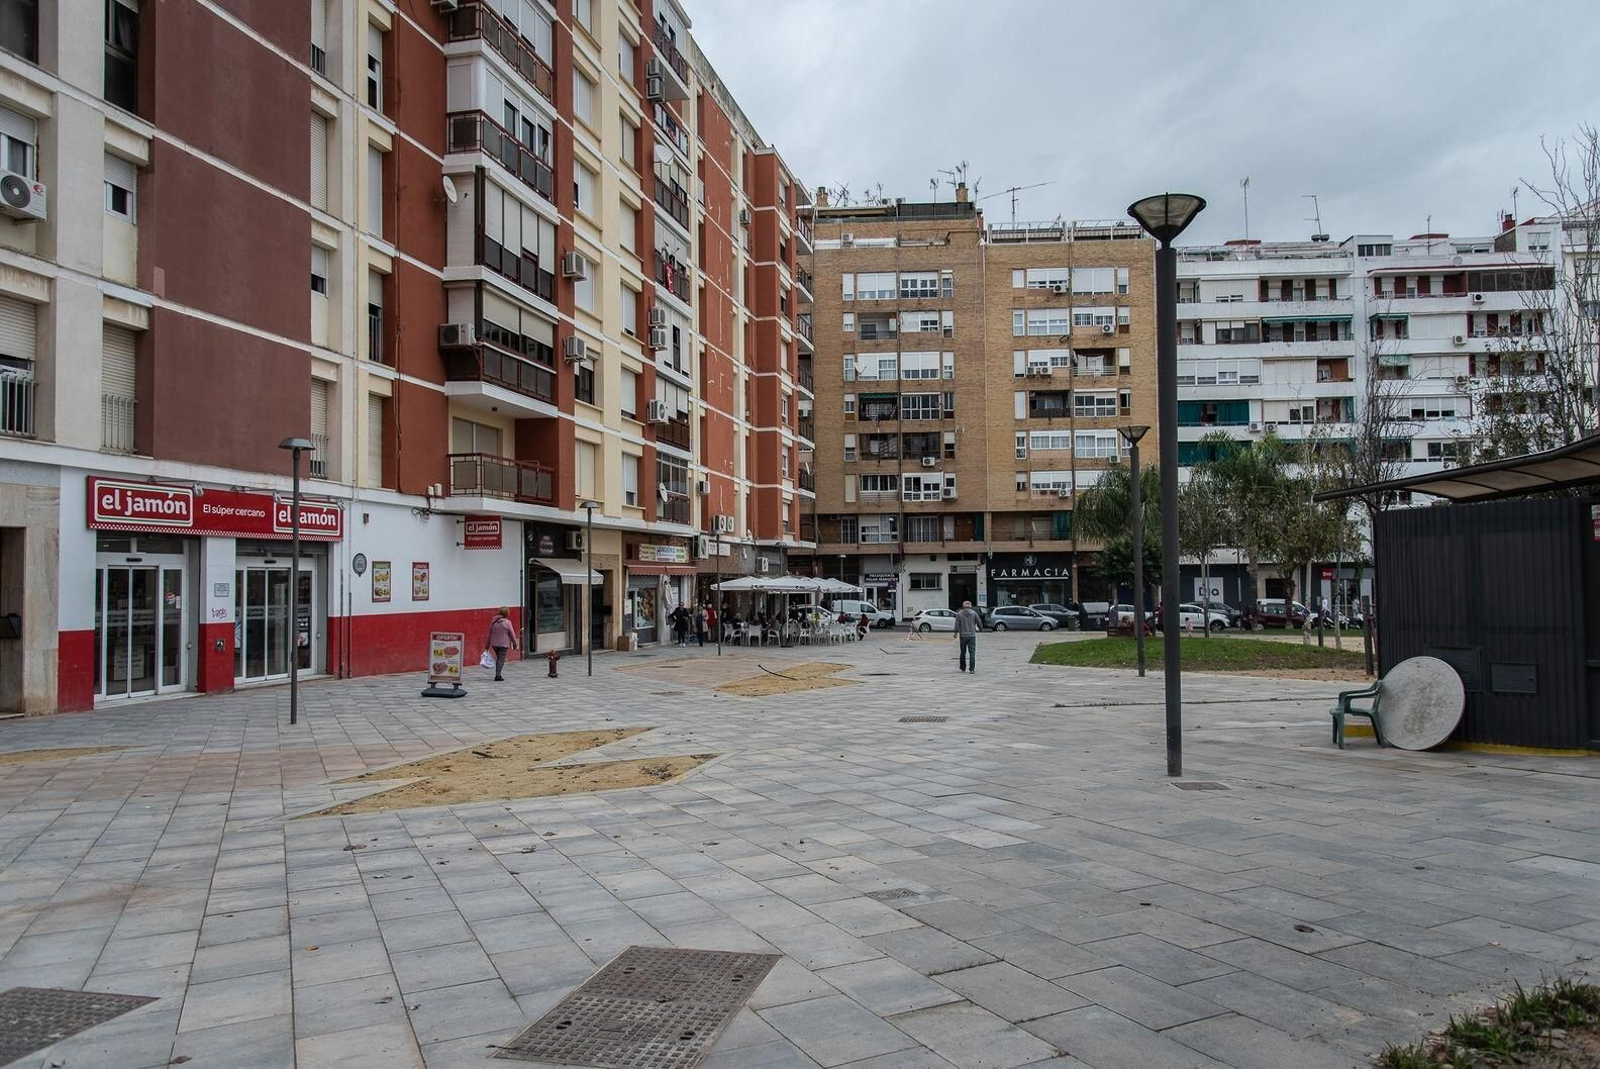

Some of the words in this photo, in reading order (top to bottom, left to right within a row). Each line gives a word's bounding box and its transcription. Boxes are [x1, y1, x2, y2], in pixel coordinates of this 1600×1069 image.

[102, 489, 121, 510] el
[124, 490, 187, 516] jamón
[203, 504, 211, 514] El
[212, 505, 235, 516] súper
[235, 508, 265, 518] cercano
[279, 505, 292, 523] el
[299, 507, 336, 526] amón
[468, 524, 475, 532] el
[475, 522, 498, 533] jamón
[991, 568, 1069, 577] FARMACIA
